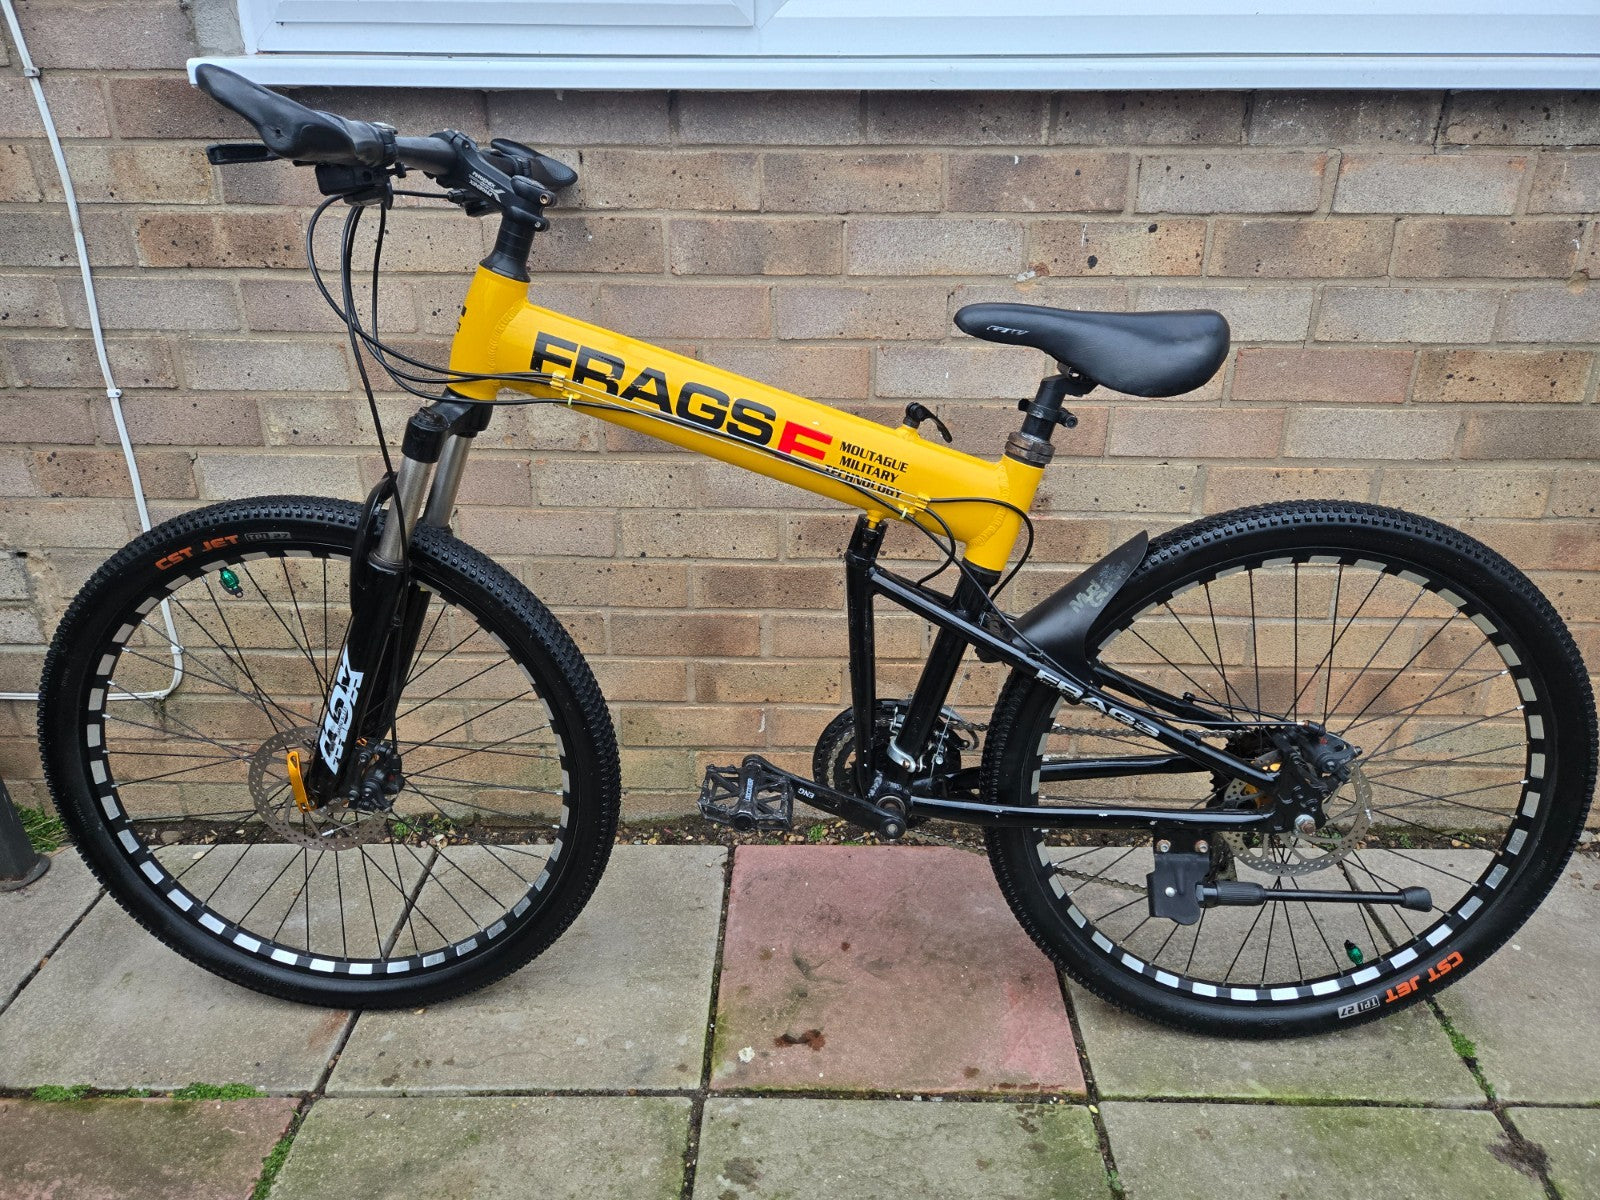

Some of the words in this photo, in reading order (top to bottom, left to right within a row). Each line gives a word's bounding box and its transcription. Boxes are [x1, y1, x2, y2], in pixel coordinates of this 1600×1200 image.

[839, 456, 899, 483] MILITARY
[840, 441, 908, 473] MOUTAGUE
[155, 546, 193, 571] CST
[202, 534, 240, 553] JET
[1427, 951, 1464, 983] CST
[1385, 975, 1420, 1003] JET
